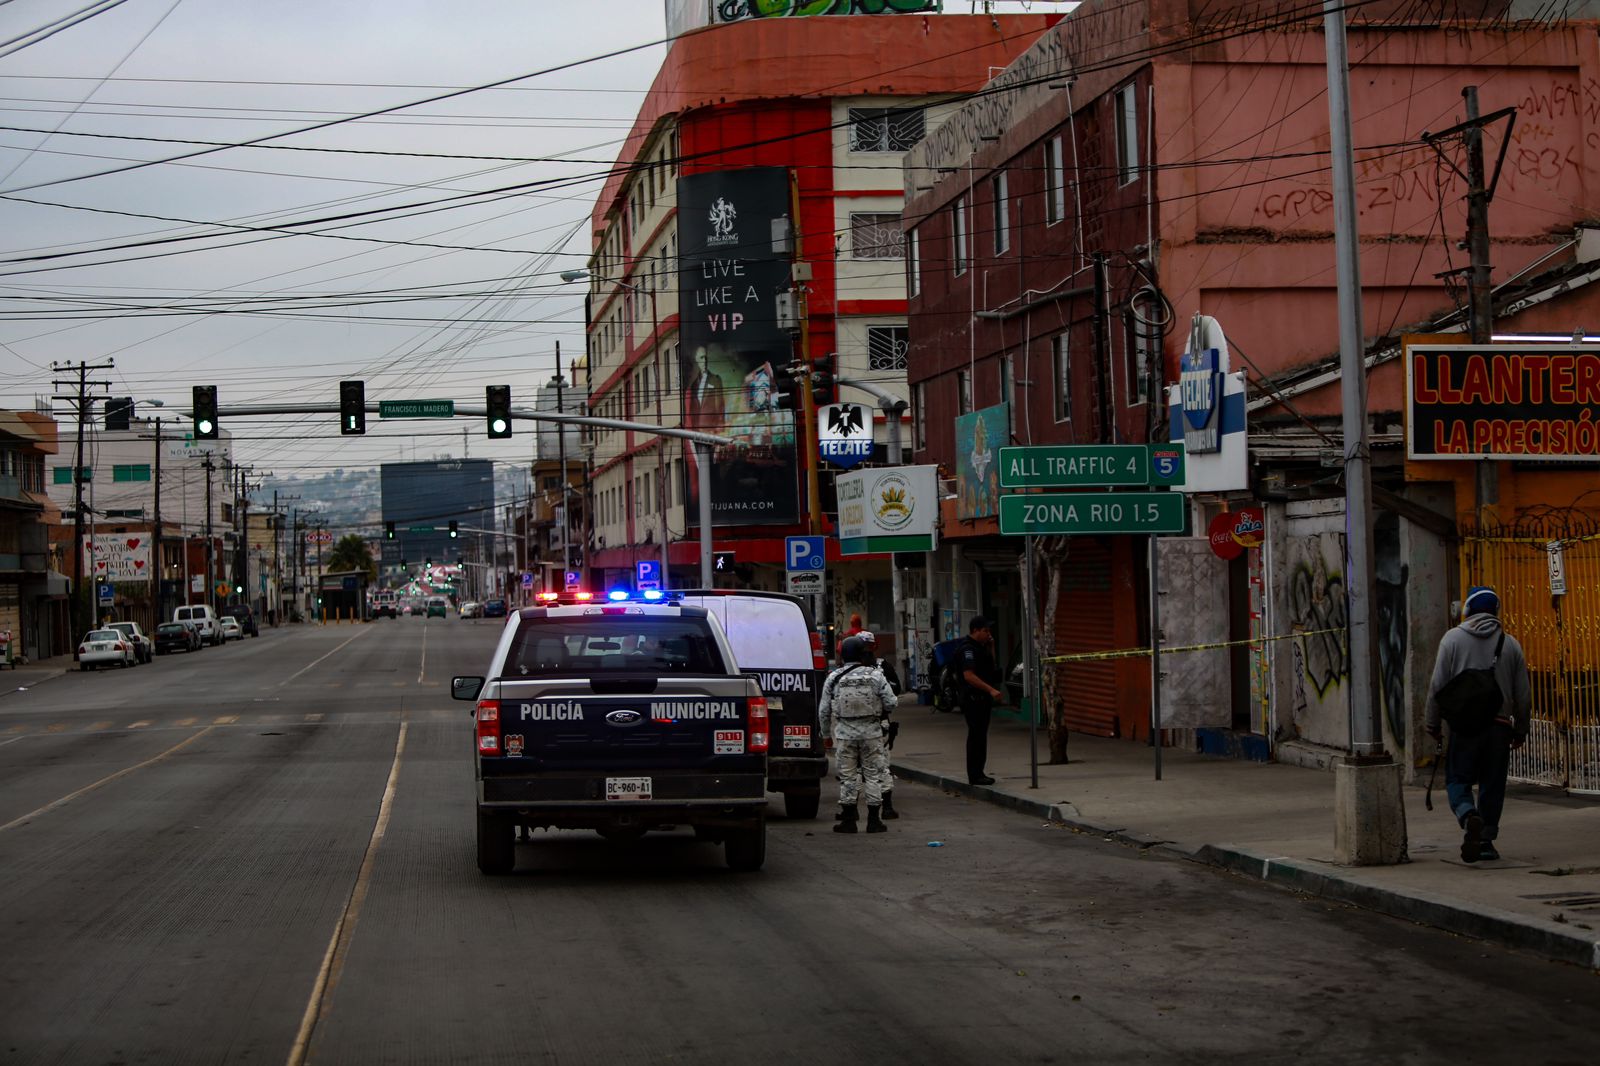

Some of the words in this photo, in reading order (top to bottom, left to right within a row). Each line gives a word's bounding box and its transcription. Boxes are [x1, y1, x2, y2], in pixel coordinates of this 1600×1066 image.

[703, 258, 745, 279] LIVE
[696, 285, 734, 307] LIKE
[745, 285, 760, 303] A
[708, 312, 744, 332] VIP
[384, 405, 417, 413] FRANCISCO
[423, 404, 449, 412] MADERO
[1434, 419, 1469, 455] LA
[1473, 408, 1600, 455] PRECISIÓ
[819, 440, 872, 456] TECATE
[1010, 458, 1040, 477] ALL
[1046, 456, 1116, 475] TRAFFIC
[1125, 456, 1137, 475] 4
[1160, 458, 1173, 474] 5
[1023, 504, 1080, 524] ZONA
[1090, 504, 1124, 522] RIO
[1133, 503, 1160, 521] 1.5
[791, 541, 811, 567] P
[640, 563, 652, 580] P
[100, 586, 109, 597] P
[759, 672, 811, 692] NICIPAL
[520, 700, 584, 721] POLICÍA
[650, 702, 740, 720] MUNICIPAL
[716, 732, 742, 741] 911
[784, 727, 810, 736] 911
[608, 783, 650, 793] BC-960-A1
